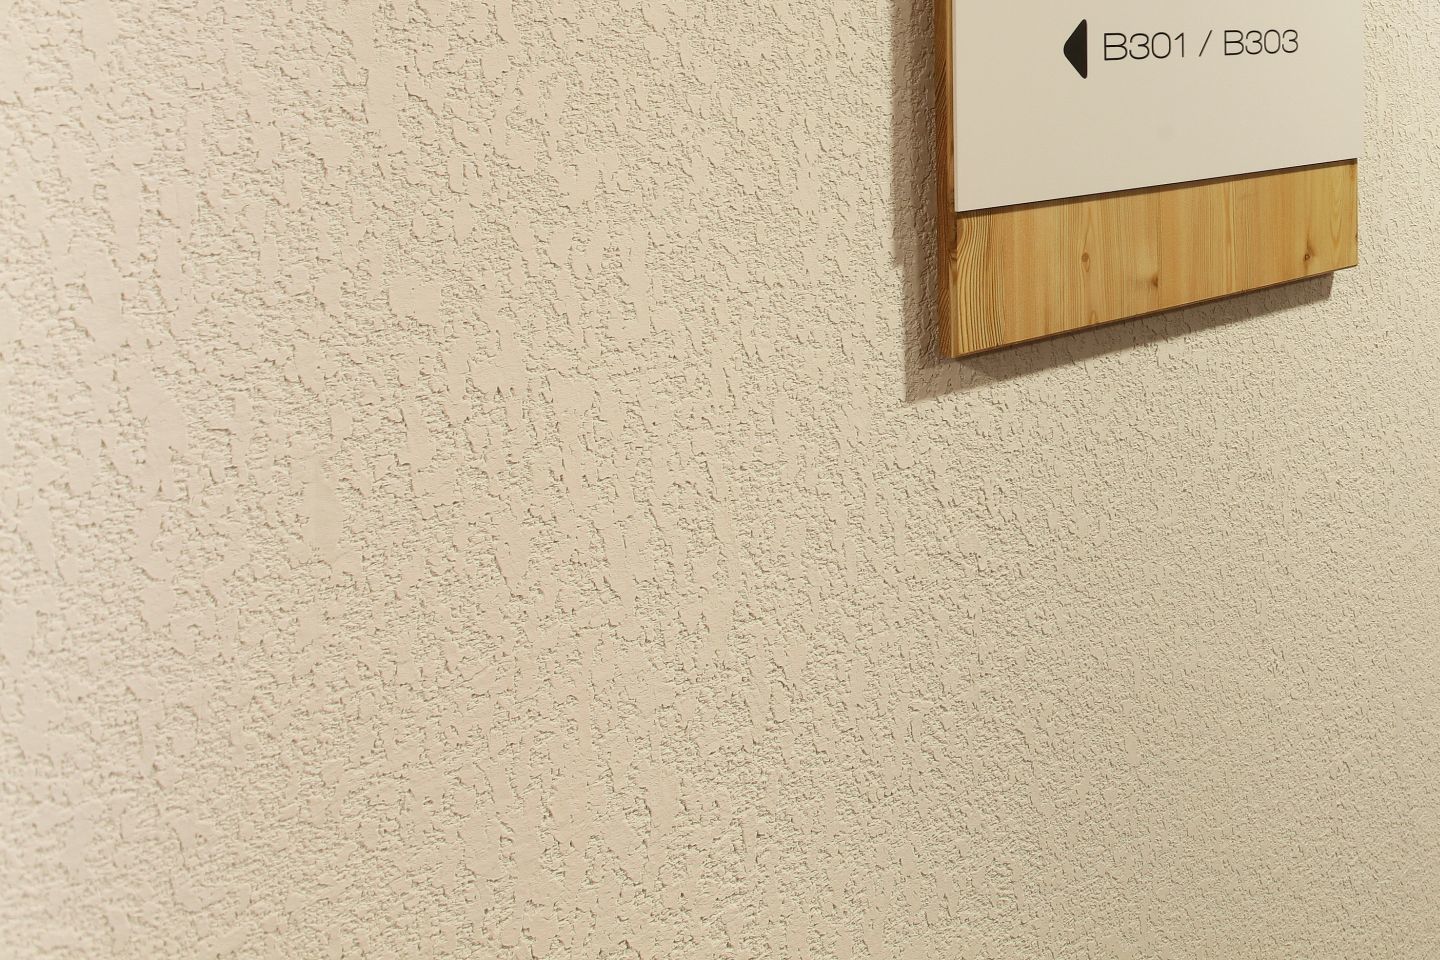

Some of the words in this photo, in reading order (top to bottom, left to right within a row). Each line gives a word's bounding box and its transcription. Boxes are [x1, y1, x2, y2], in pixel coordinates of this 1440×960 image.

[1103, 32, 1186, 61] B301
[1198, 29, 1213, 58] /
[1223, 28, 1299, 56] B303
